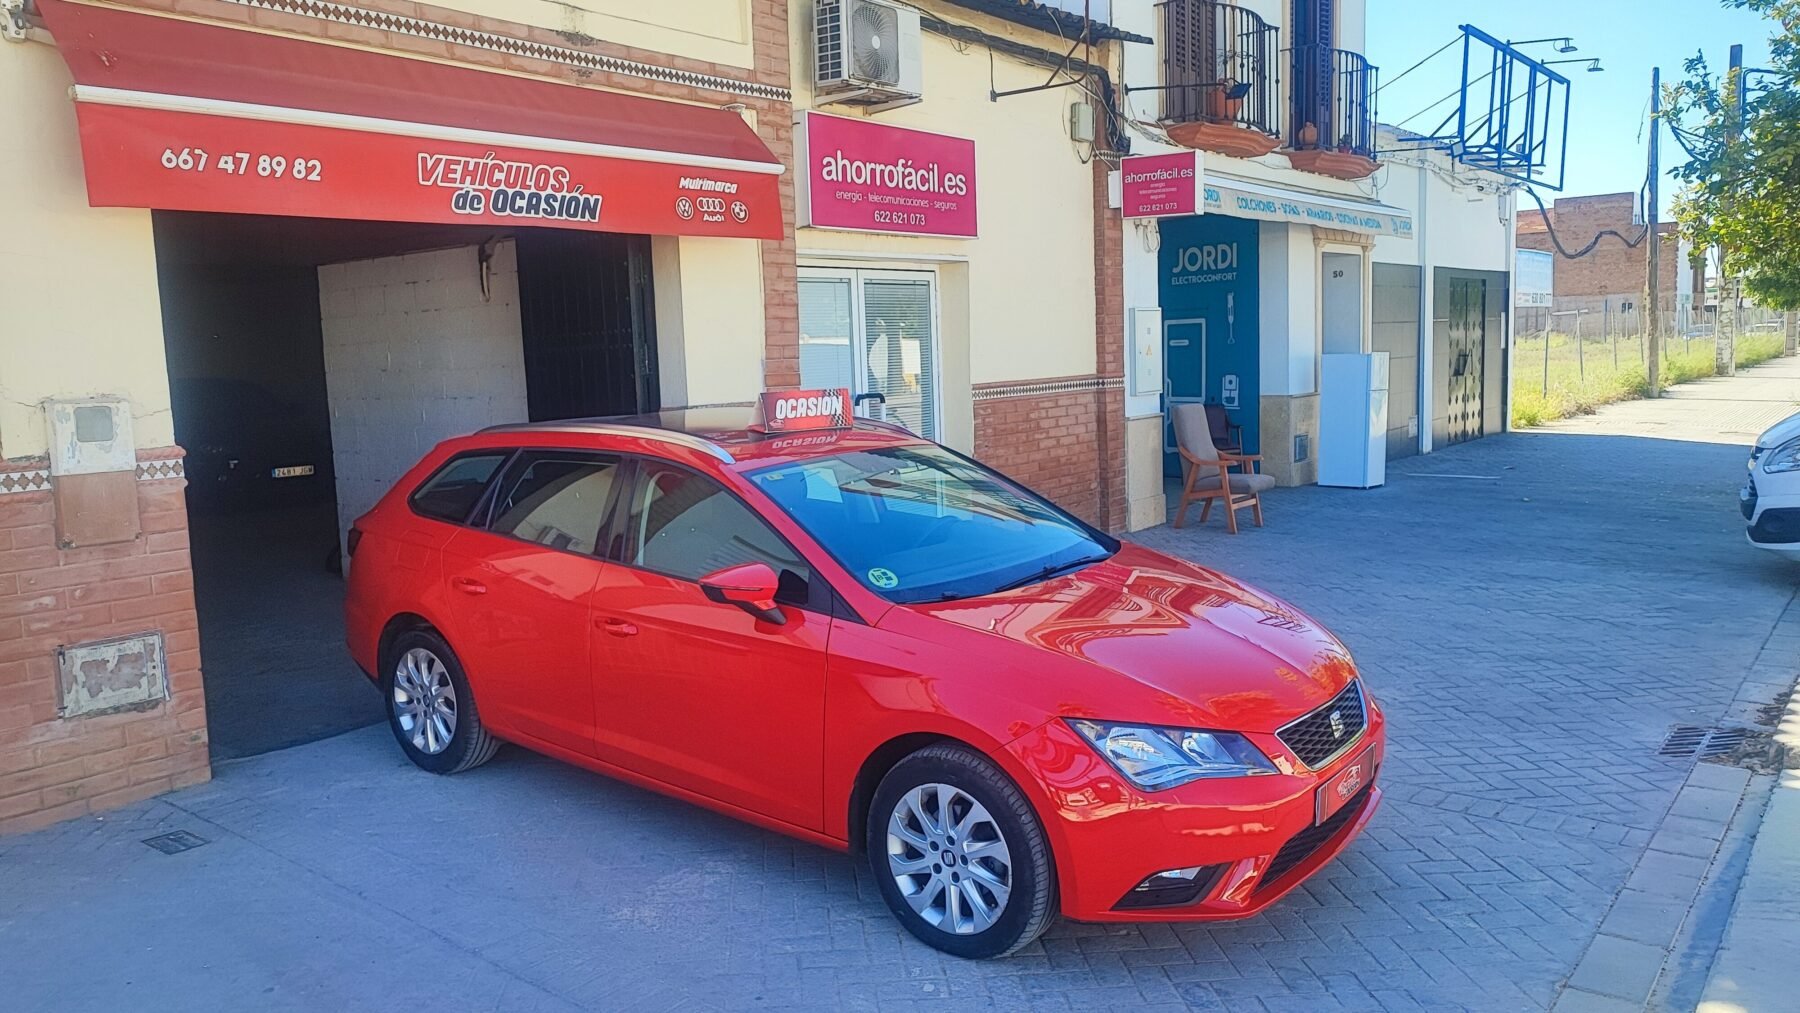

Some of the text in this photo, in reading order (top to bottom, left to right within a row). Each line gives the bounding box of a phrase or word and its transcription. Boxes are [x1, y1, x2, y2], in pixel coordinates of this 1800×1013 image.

[161, 148, 322, 182] 667 47 89 82
[418, 152, 570, 193] VEHÍCULOS
[821, 149, 967, 196] ahorrofácil.es
[1124, 167, 1193, 184] ahorrofácil.es
[452, 185, 602, 223] de OCASIÓN
[868, 192, 929, 208] telecomunicaciones
[934, 200, 957, 211] seguros
[1165, 202, 1178, 210] 073
[1236, 196, 1276, 213] COLCHONES
[703, 213, 725, 222] Audi
[874, 210, 926, 226] 622 621 073
[1172, 242, 1238, 273] JORDI
[1171, 272, 1237, 285] ELECTROCONFORT
[1332, 270, 1344, 278] 50
[775, 395, 843, 419] OCASION
